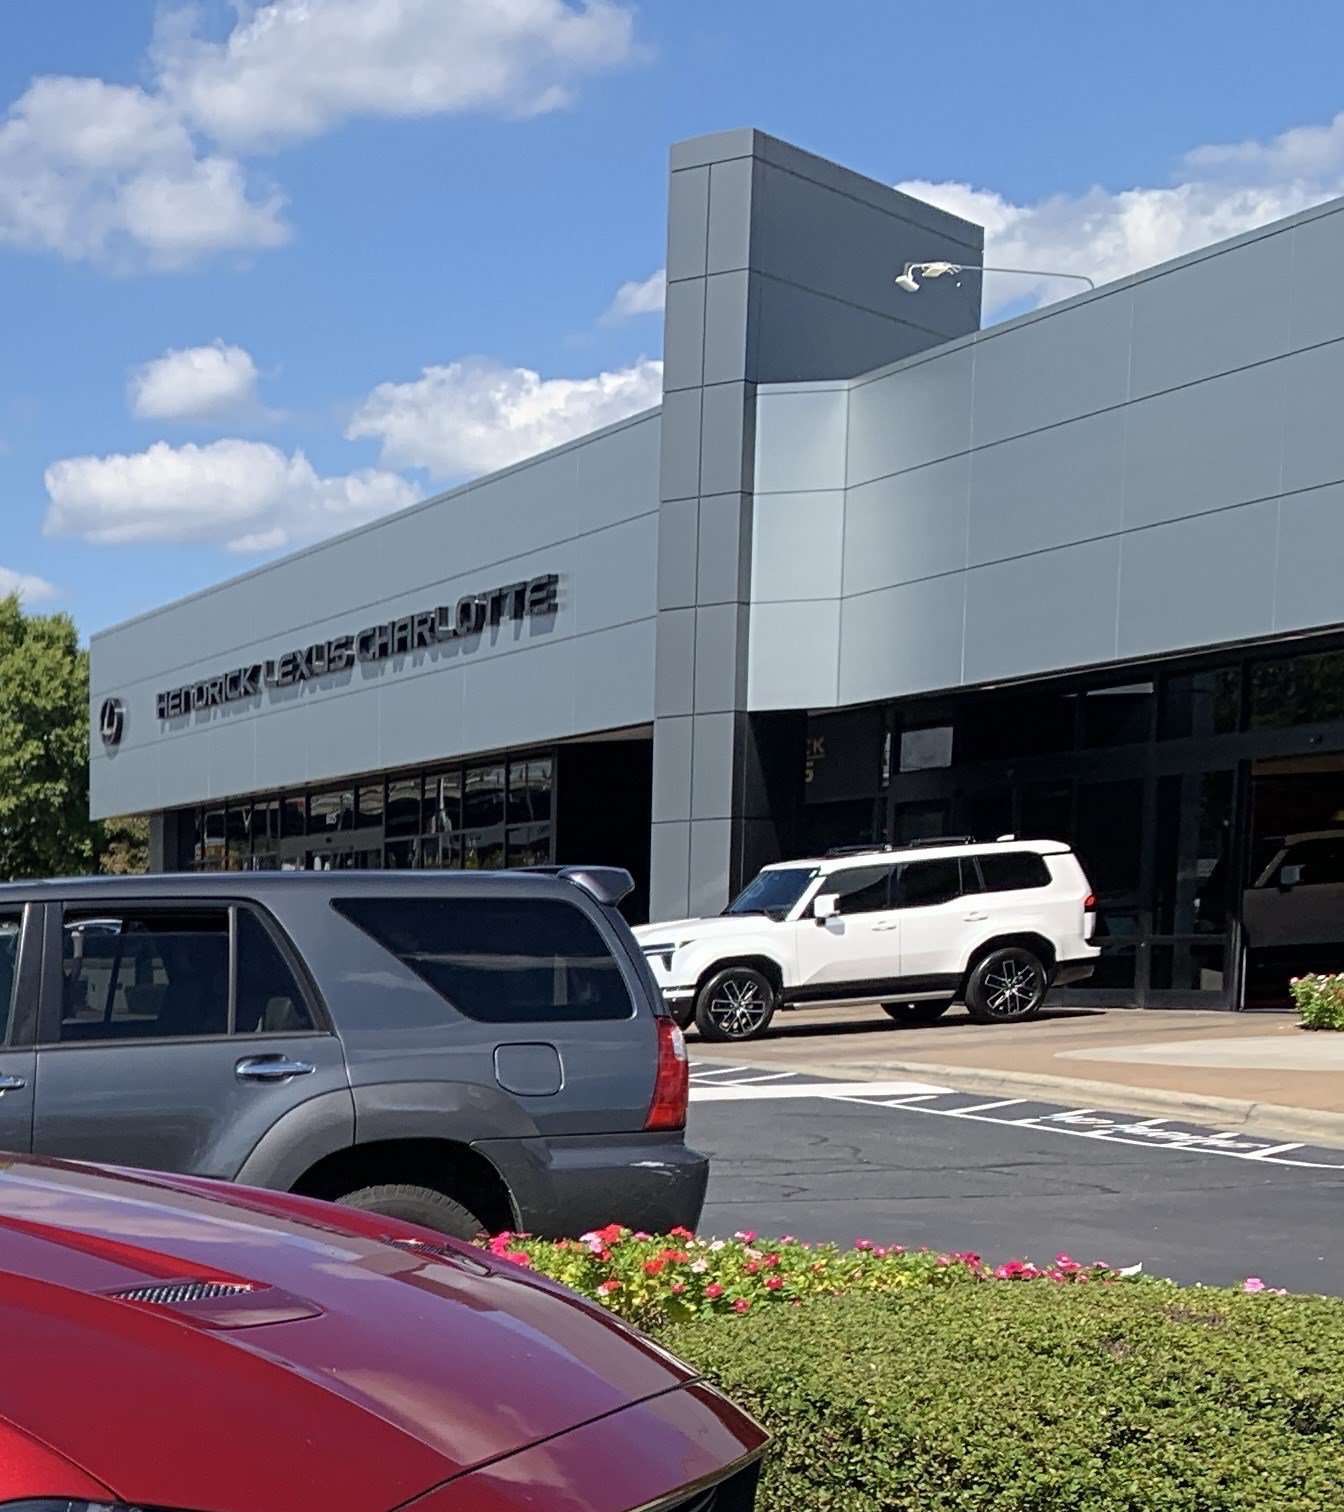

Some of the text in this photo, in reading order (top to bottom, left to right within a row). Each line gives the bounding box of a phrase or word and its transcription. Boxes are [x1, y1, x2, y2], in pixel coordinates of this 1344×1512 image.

[156, 574, 559, 720] HENDRICK LEXUS CHARLOTTE
